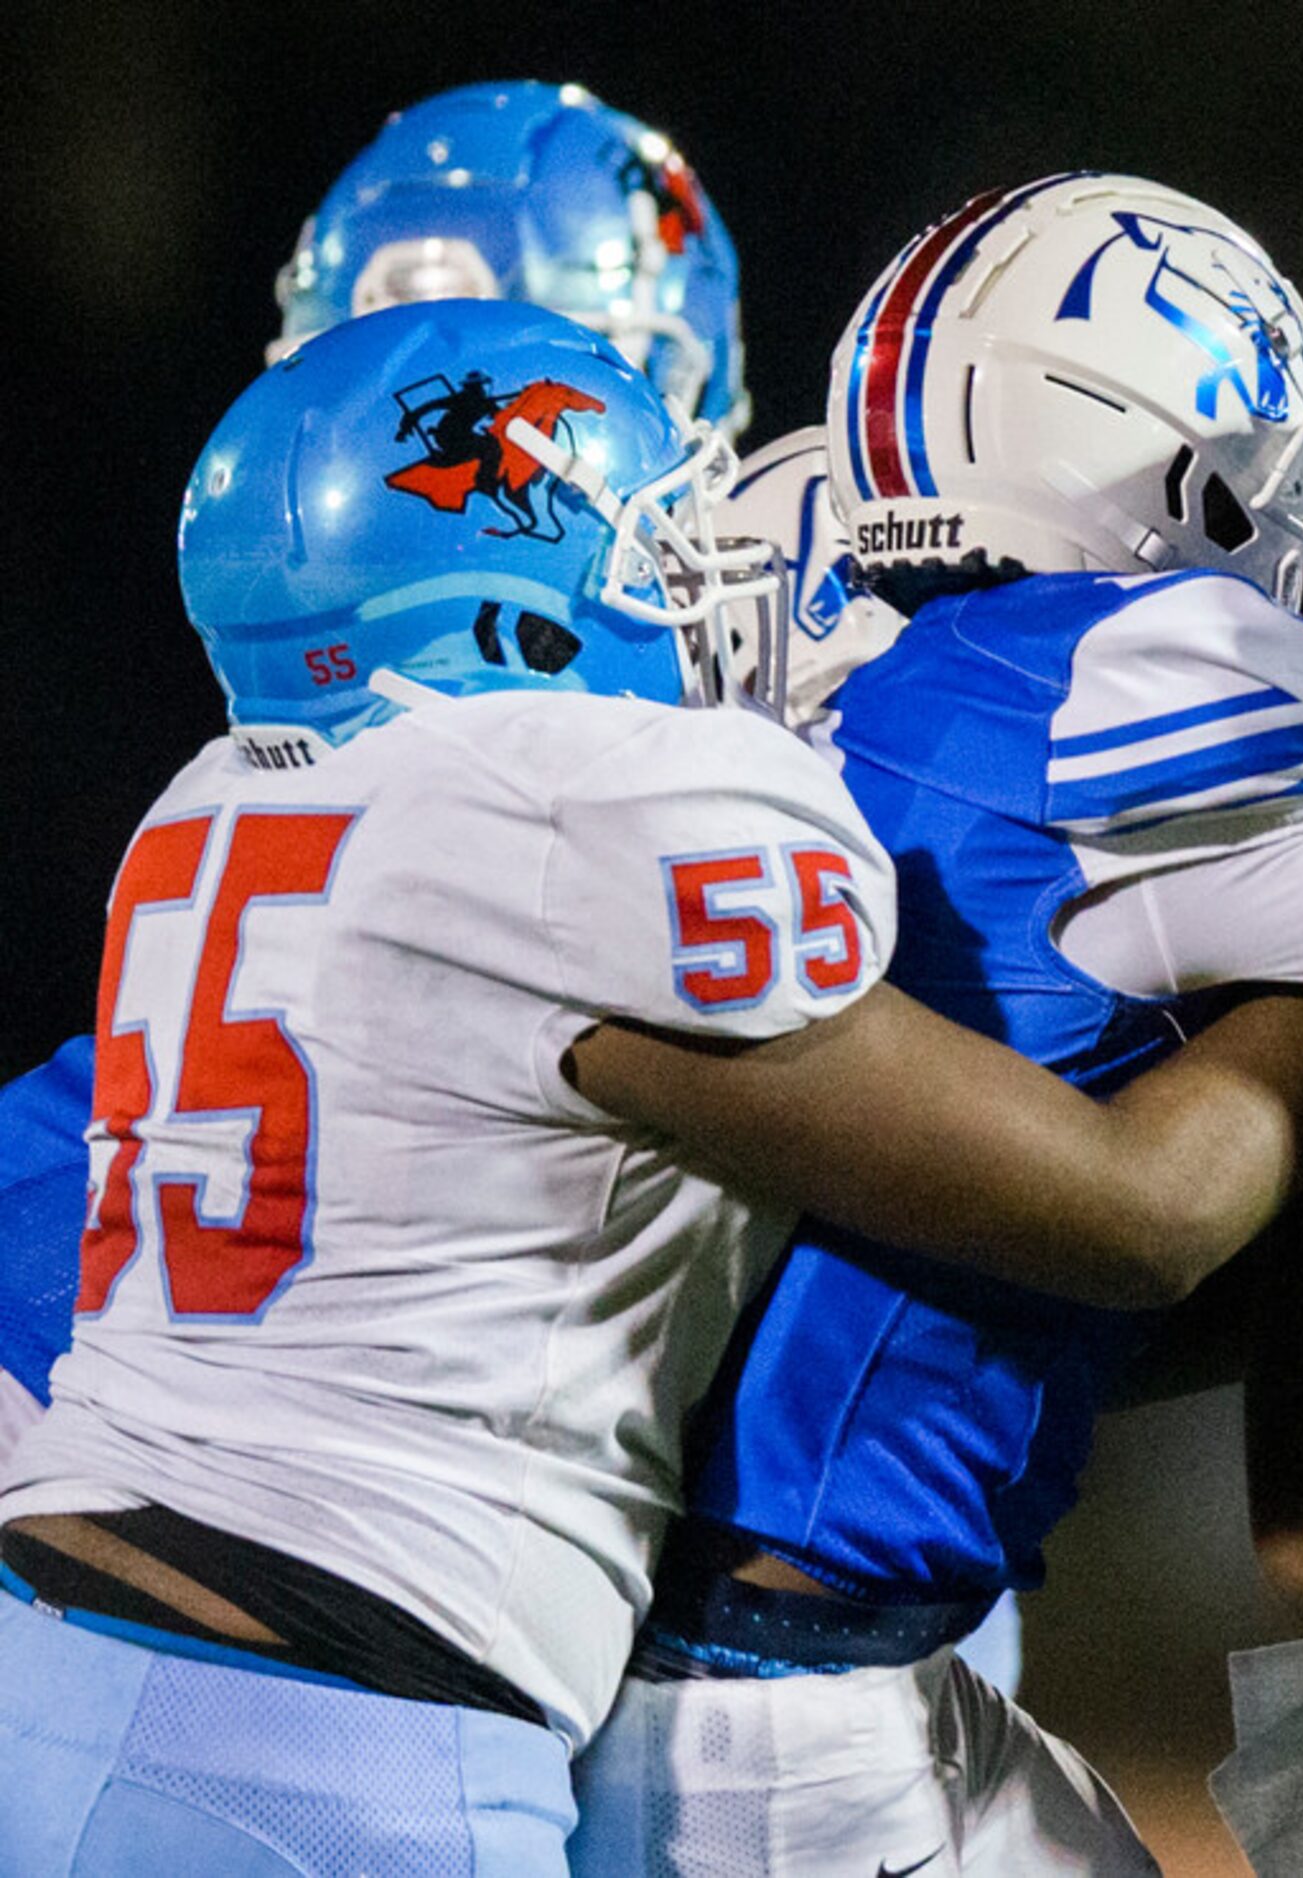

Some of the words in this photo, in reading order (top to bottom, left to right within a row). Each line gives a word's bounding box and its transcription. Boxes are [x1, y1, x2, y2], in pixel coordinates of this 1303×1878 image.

[857, 509, 964, 555] schutt
[304, 643, 357, 686] 55
[658, 841, 868, 1016] 55
[72, 805, 376, 1326] 55
